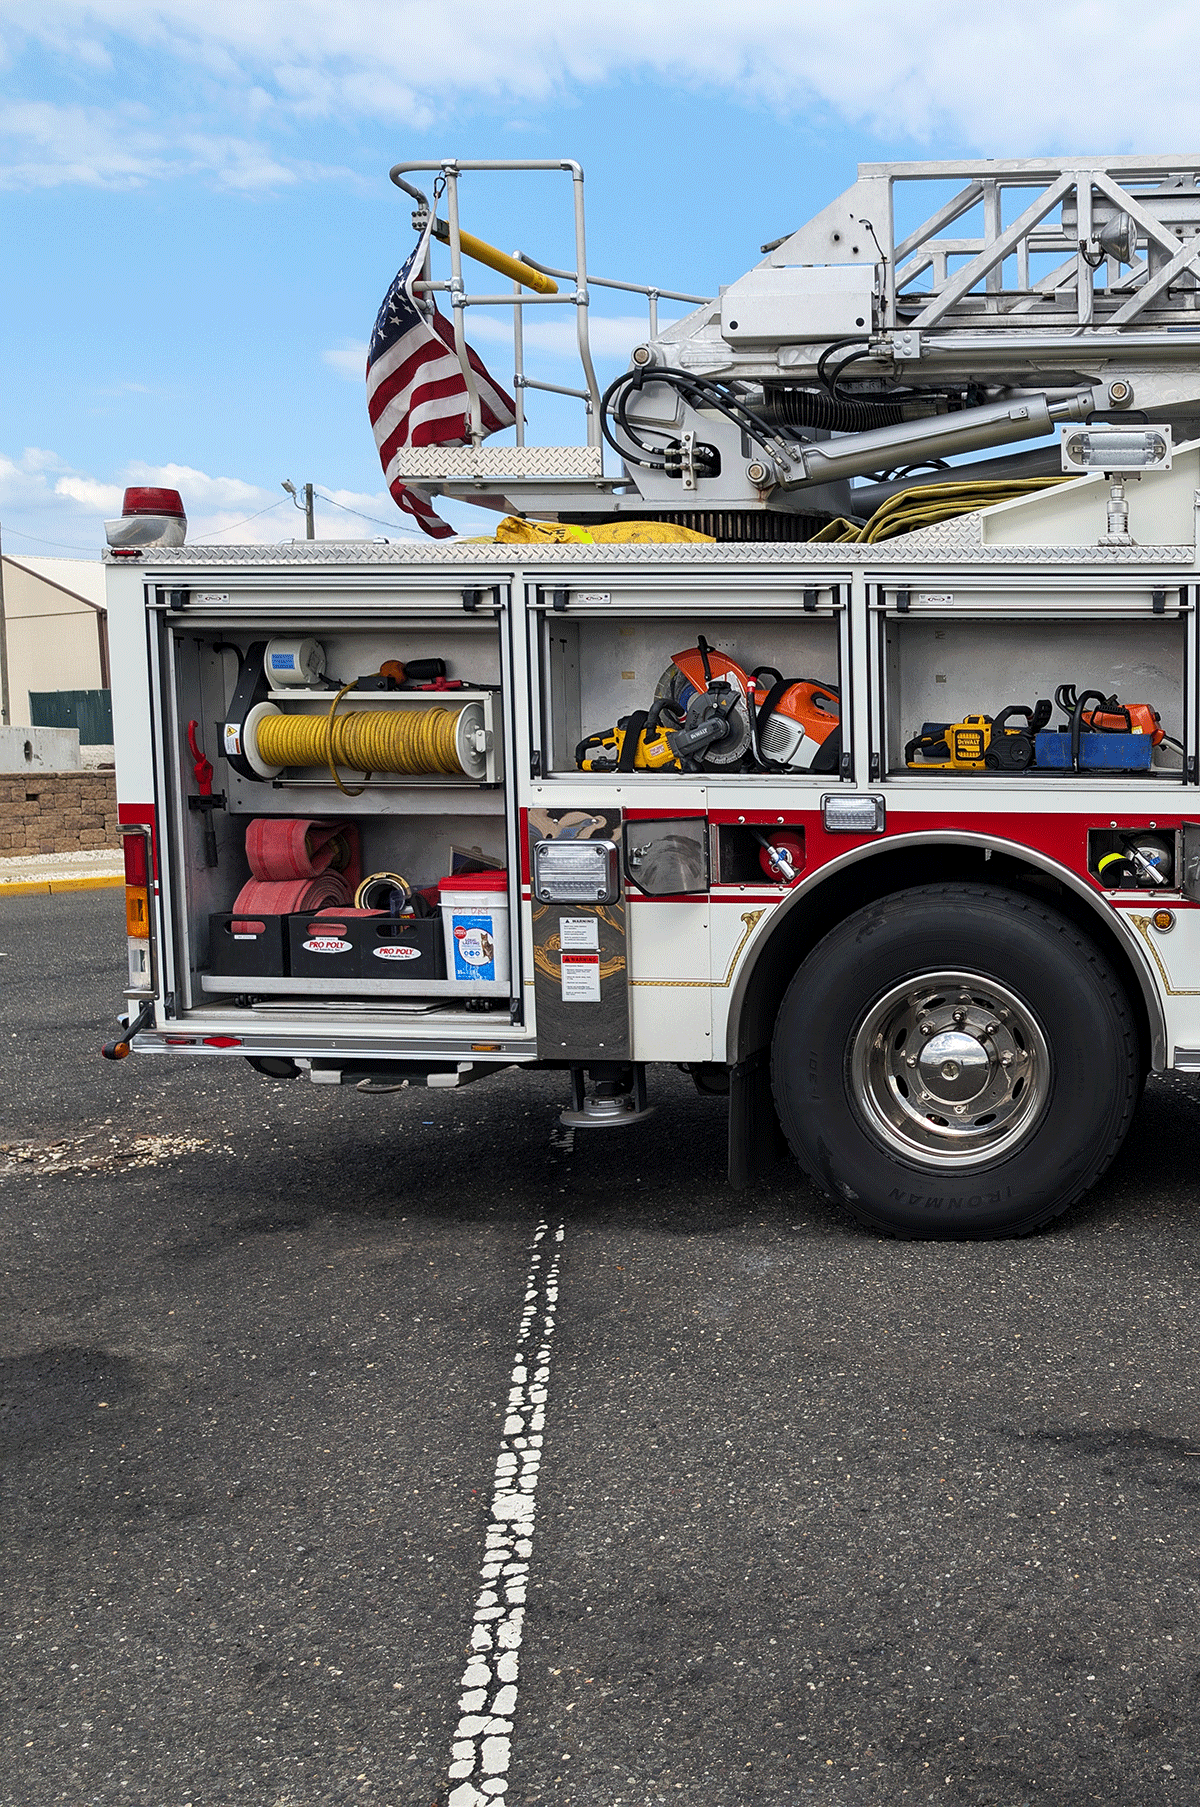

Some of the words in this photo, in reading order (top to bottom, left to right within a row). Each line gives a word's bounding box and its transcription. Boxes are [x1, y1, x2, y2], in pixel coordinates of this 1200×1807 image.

[309, 941, 324, 949] PRO
[325, 941, 345, 949] POLY
[887, 1184, 1013, 1210] IRONMAN
